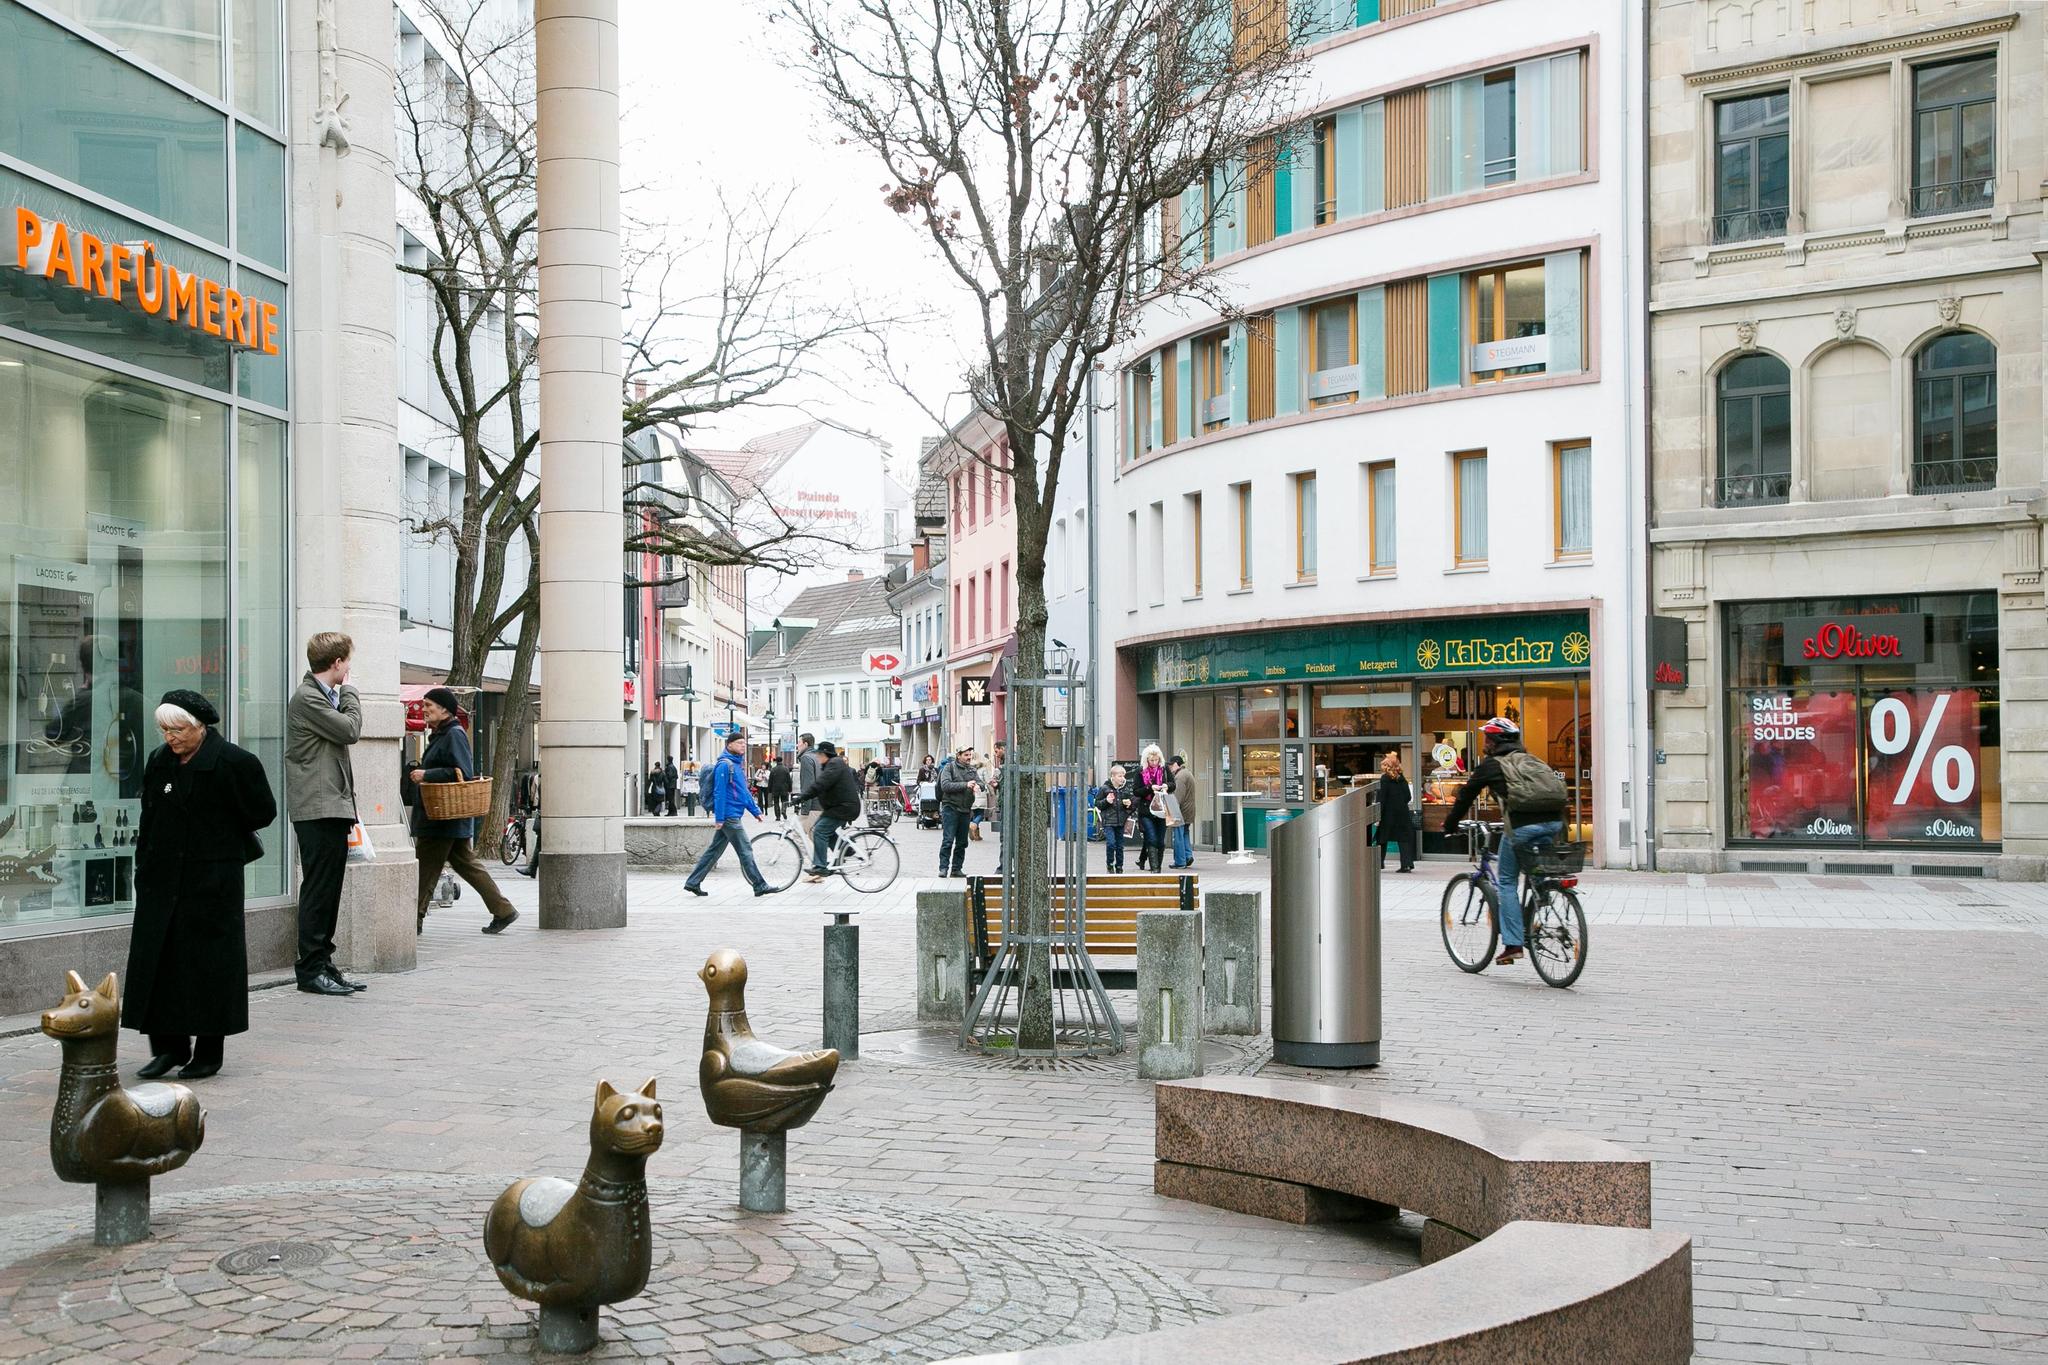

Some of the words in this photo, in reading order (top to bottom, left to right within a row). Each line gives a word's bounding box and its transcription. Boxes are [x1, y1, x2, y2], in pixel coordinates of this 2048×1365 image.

[16, 206, 280, 356] PARFÜMERIE
[1488, 344, 1536, 360] STEGMANN
[96, 523, 126, 537] LACOSTE
[35, 567, 65, 581] LACOSTE
[79, 594, 93, 606] NEW
[1803, 622, 1902, 660] s.Oliver
[1445, 637, 1554, 667] Kalbacher
[1264, 665, 1287, 675] Imbiss
[1305, 662, 1336, 673] Feinkost
[1359, 658, 1398, 672] Metzgerei
[1753, 697, 1792, 711] SALE
[1753, 712, 1798, 726] SALDI
[1753, 726, 1816, 741] SOLDES
[1870, 694, 1975, 805] %
[1806, 817, 1853, 836] s.Oliver
[1925, 818, 1976, 837] s.Oliver
